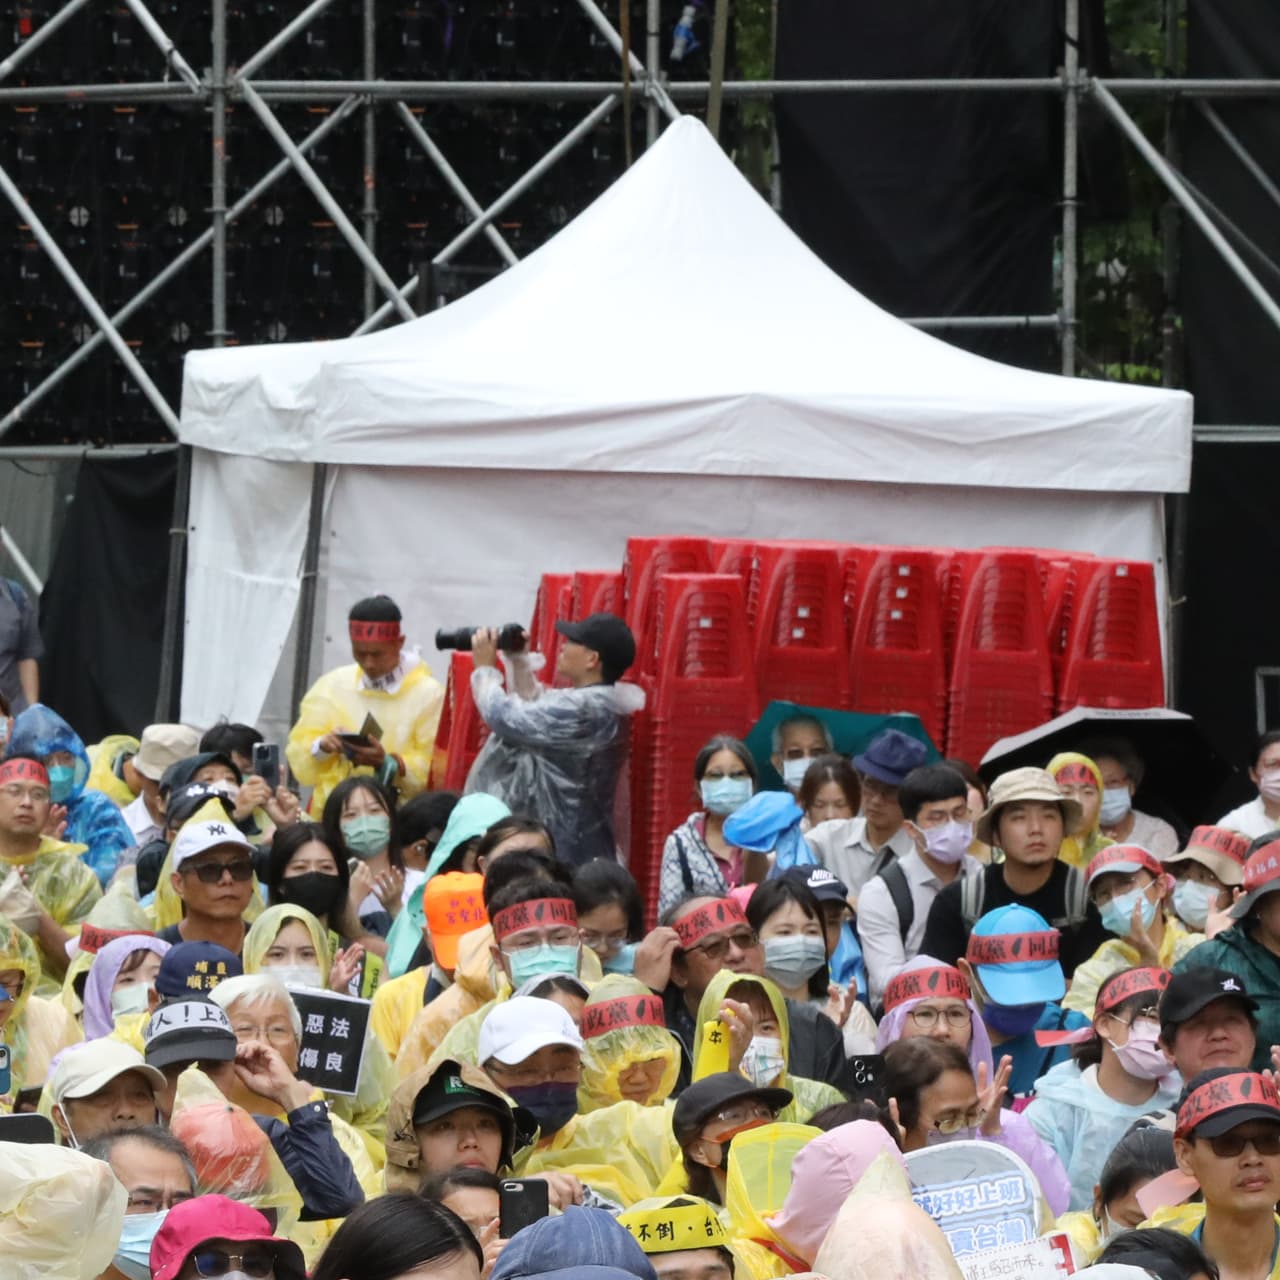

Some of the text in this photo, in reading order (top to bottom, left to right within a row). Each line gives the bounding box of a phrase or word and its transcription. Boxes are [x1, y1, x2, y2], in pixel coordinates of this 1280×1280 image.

[812, 869, 834, 881] NIKE
[305, 1014, 351, 1039] 惡法
[300, 1049, 344, 1073] 傷良
